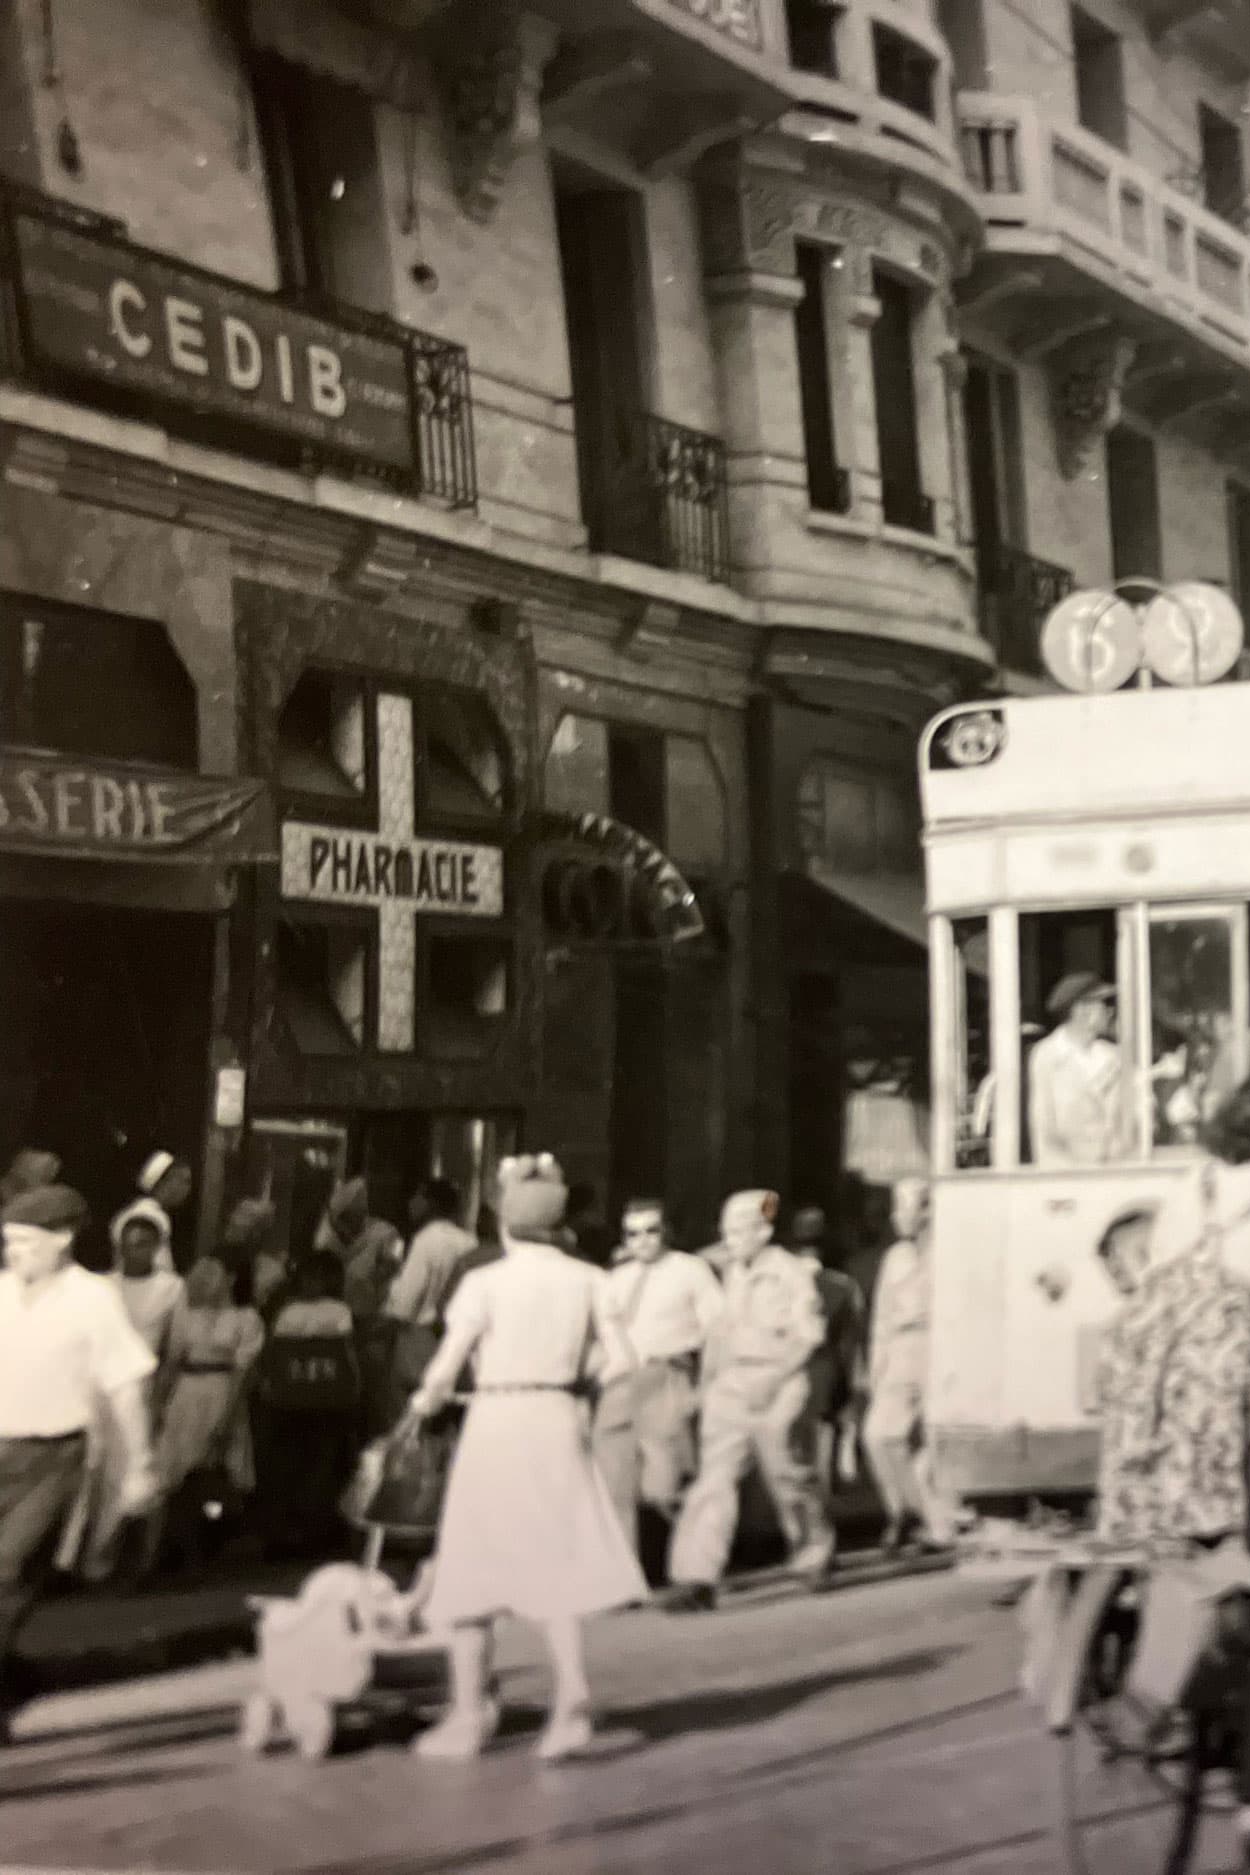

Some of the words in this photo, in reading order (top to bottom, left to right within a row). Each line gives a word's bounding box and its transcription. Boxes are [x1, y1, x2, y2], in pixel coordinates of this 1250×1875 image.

[108, 277, 347, 419] CEDIB
[0, 768, 186, 844] SERIE
[310, 837, 480, 903] PHARMACIE
